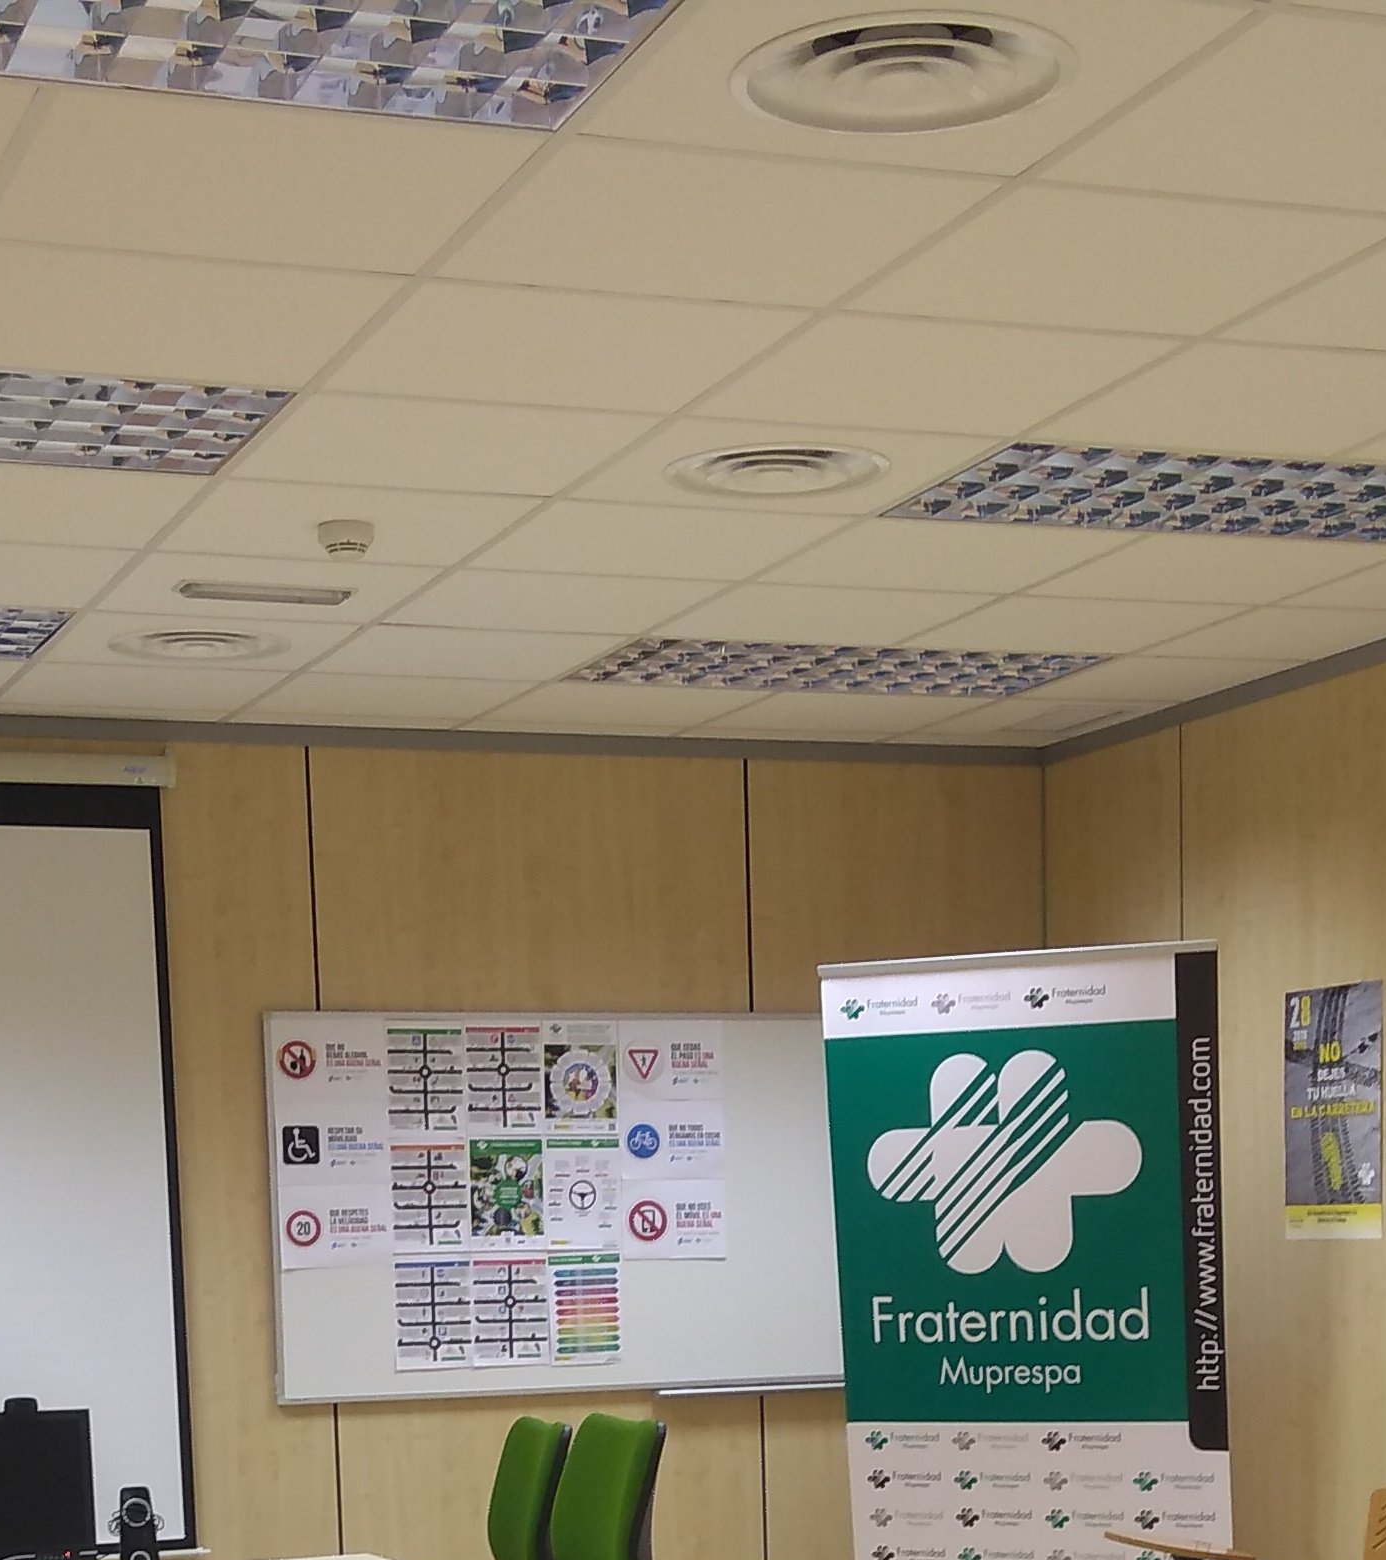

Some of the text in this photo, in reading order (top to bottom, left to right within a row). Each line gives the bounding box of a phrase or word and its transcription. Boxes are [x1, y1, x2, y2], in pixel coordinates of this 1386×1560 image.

[1052, 984, 1106, 998] Fraternidad
[867, 996, 919, 1010] Fraternidad
[1319, 1041, 1342, 1065] NO
[1317, 1067, 1346, 1082] DEJES
[1307, 1087, 1319, 1101] TU
[1188, 1036, 1225, 1392] http://www.fraternidad.com
[296, 1221, 312, 1236] 20
[871, 1286, 1151, 1344] Fraternidad
[939, 1356, 1082, 1394] Muprespa
[1069, 1432, 1122, 1443] Fraternidad
